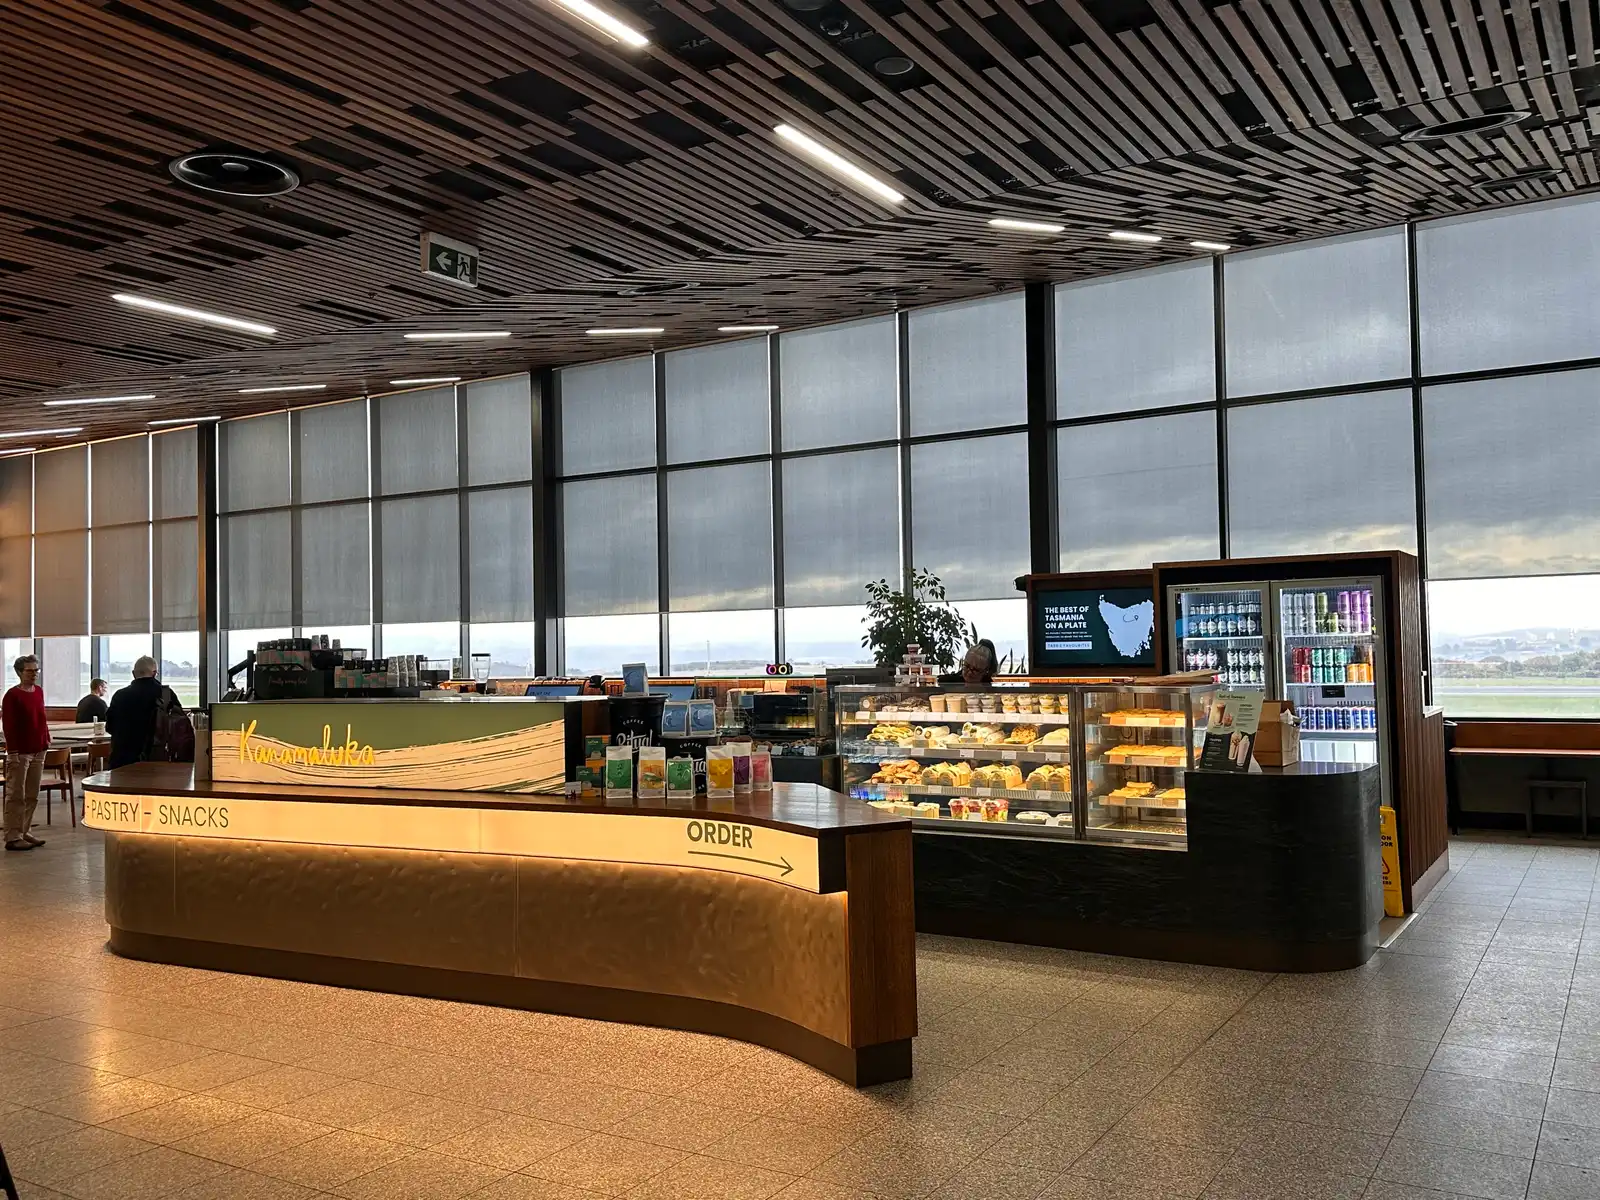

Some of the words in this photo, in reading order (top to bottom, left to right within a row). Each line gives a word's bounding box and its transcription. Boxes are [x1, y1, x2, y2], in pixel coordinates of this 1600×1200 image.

[240, 719, 375, 766] Kanamaluka
[616, 728, 653, 750] Ritual
[91, 799, 139, 822] PASTRY
[159, 804, 229, 828] SNACKS
[687, 820, 753, 849] ORDER
